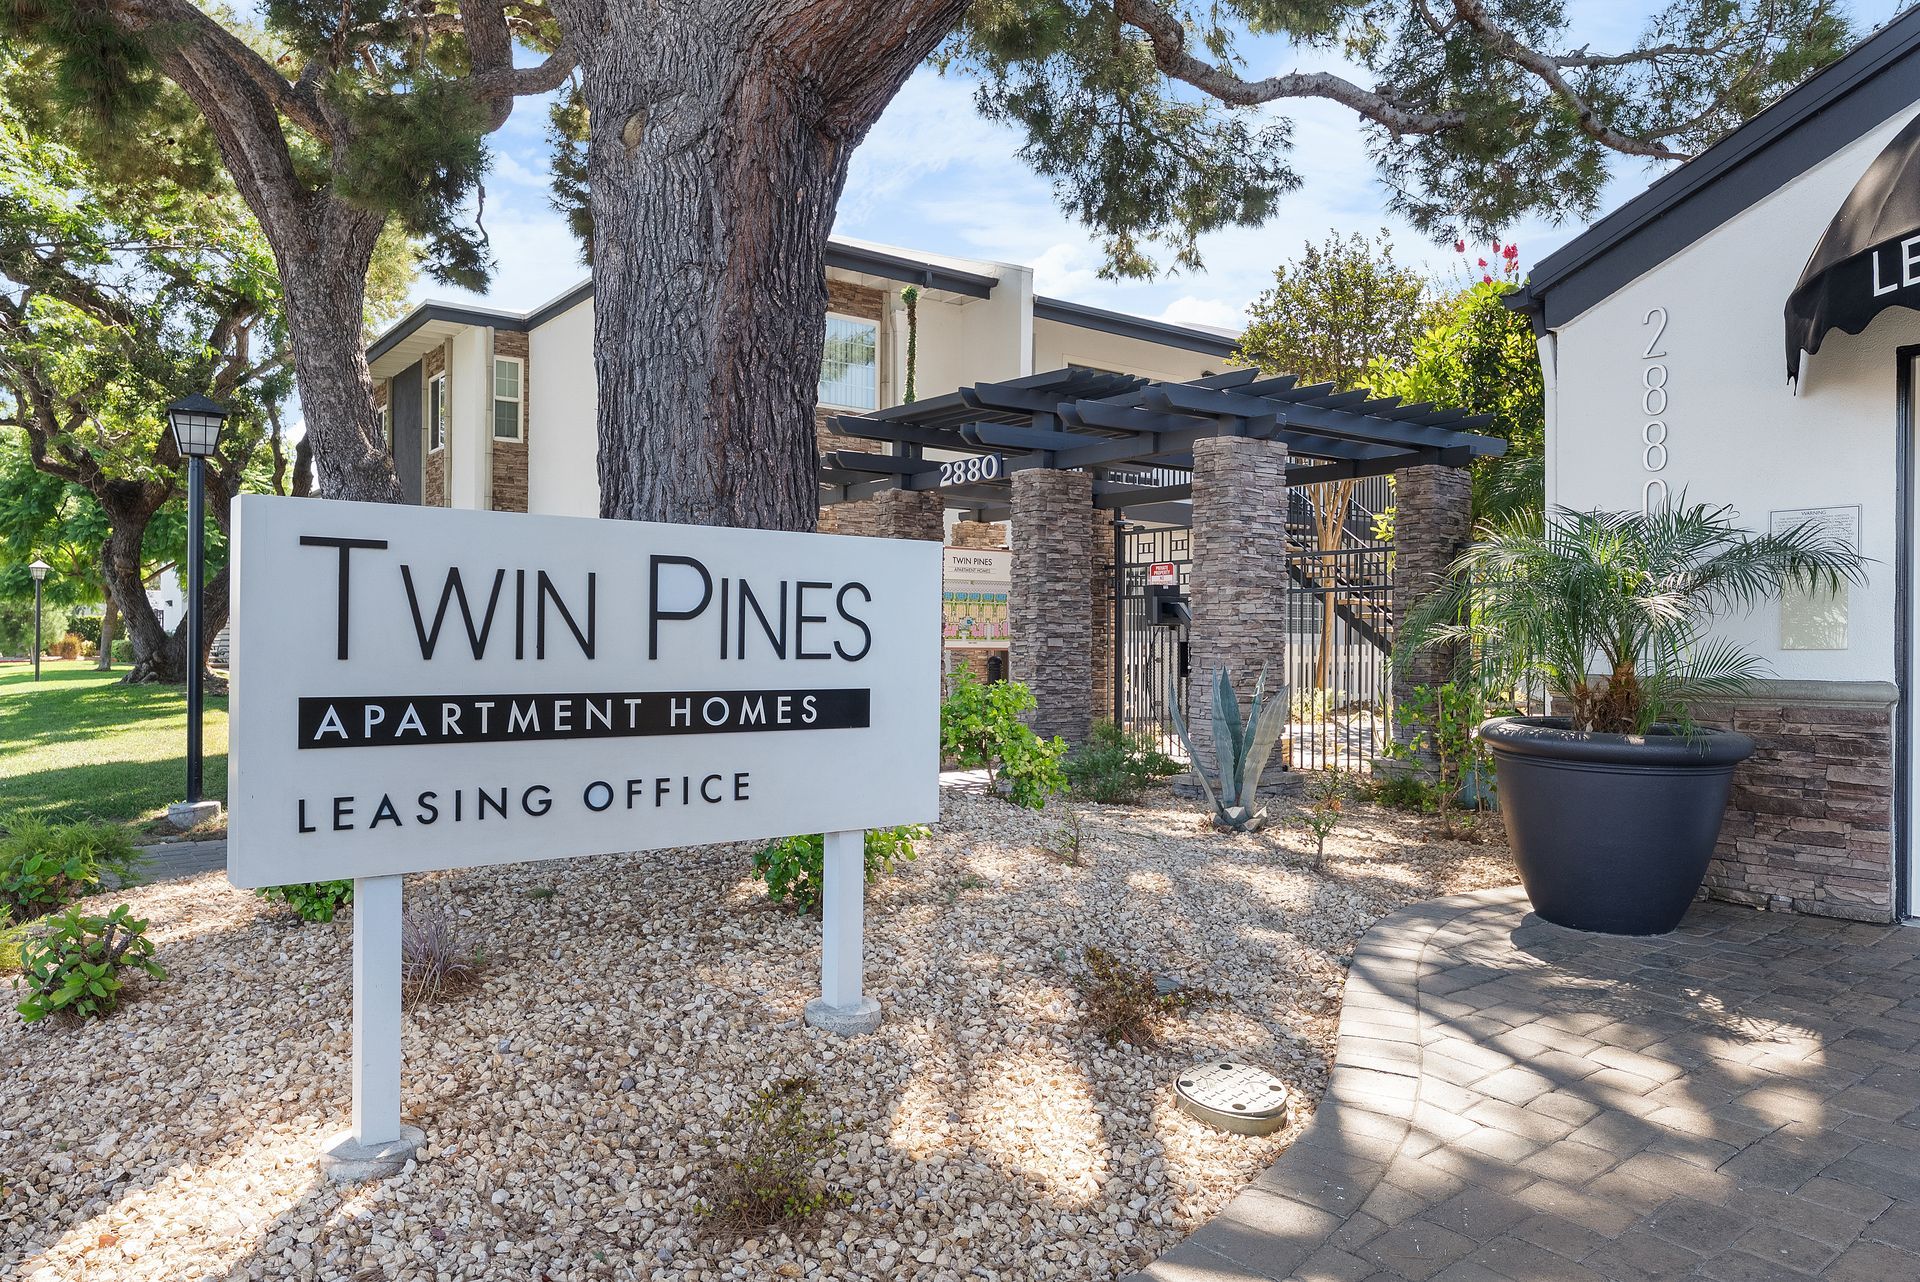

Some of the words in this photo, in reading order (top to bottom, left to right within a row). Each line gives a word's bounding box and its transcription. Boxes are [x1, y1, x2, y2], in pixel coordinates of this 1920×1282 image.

[940, 454, 999, 488] 2880
[952, 556, 972, 565] TWIN
[973, 557, 993, 566] PINES
[299, 535, 597, 661] TWIN
[648, 554, 872, 663] PINES
[313, 698, 643, 741] APARTMENT
[670, 694, 819, 728] HOMES
[298, 784, 553, 834] LEASING
[583, 772, 751, 812] OFFICE
